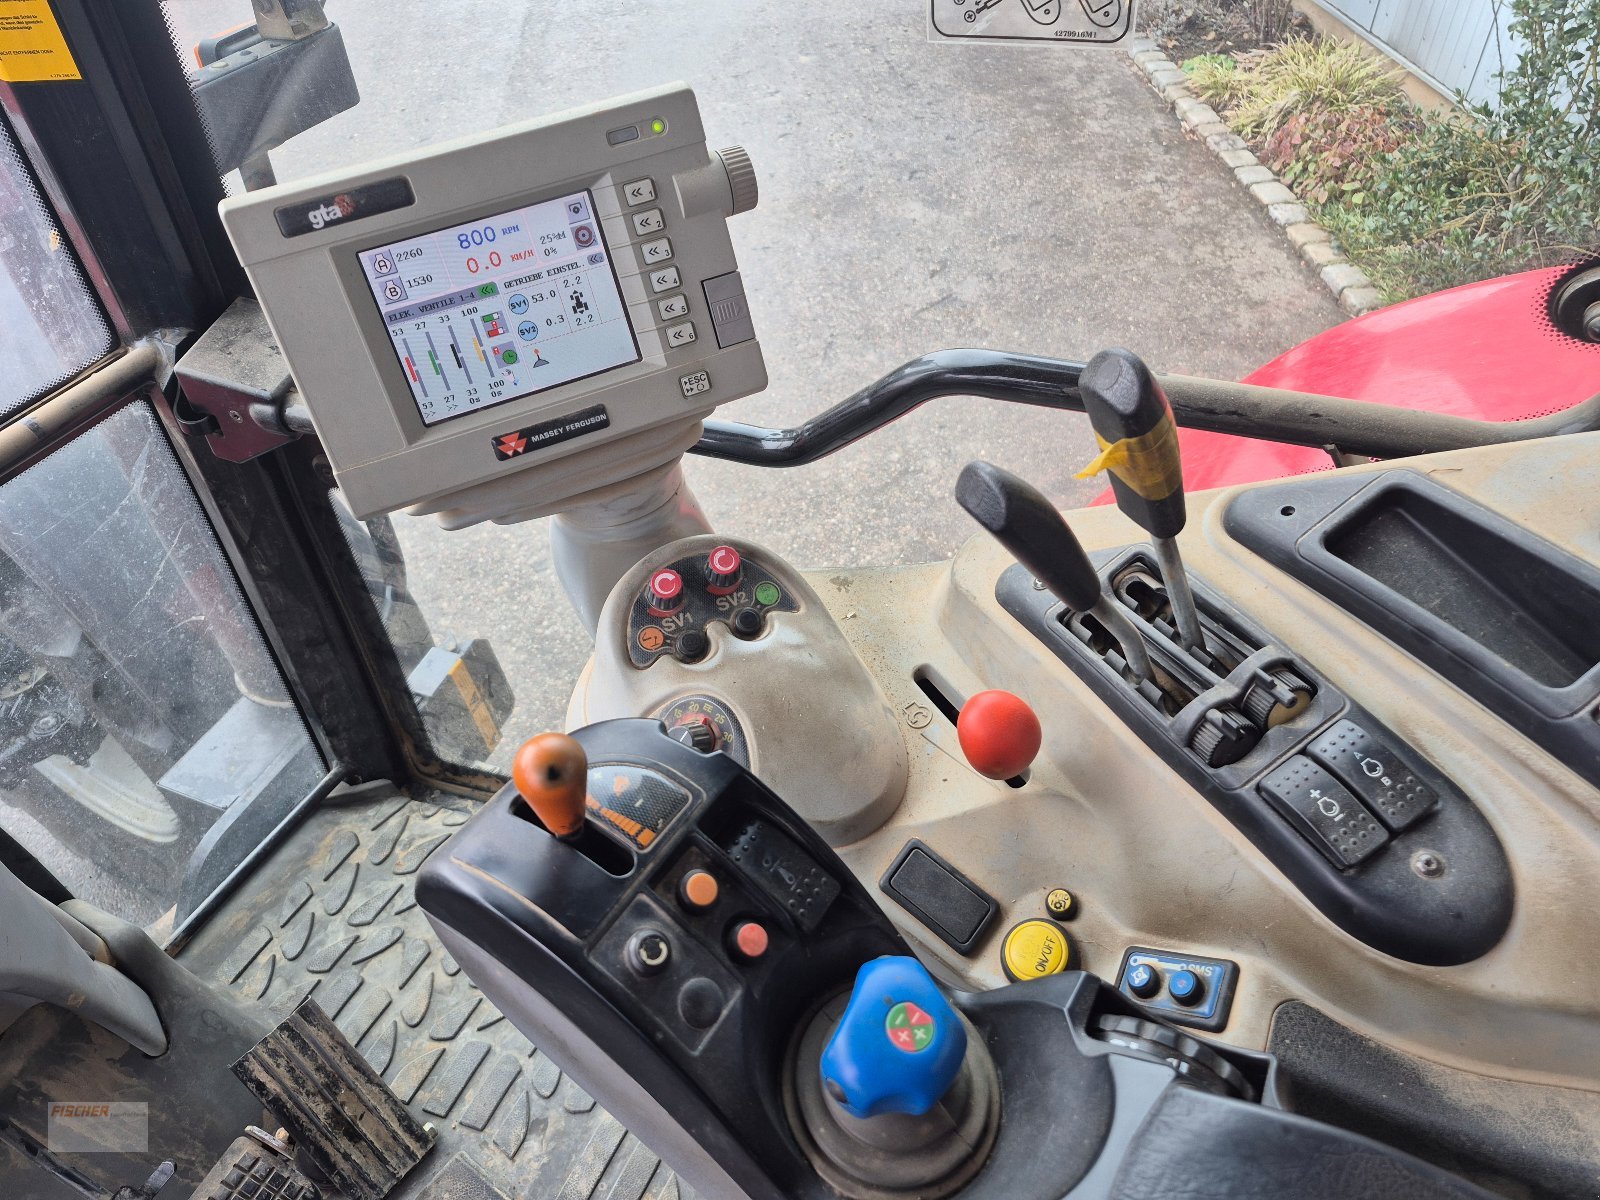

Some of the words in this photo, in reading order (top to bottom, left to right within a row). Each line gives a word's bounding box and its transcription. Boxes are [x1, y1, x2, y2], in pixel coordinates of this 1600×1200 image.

[1054, 30, 1097, 39] 4279916M1
[656, 220, 662, 228] 2
[458, 226, 496, 249] 800
[502, 225, 520, 236] RPM
[395, 247, 423, 262] 2260
[544, 247, 557, 257] 0%
[665, 249, 670, 257] 3
[378, 259, 388, 271] A
[467, 251, 501, 273] 0.0
[510, 249, 535, 263] KM/H
[406, 274, 433, 289] 1530
[504, 272, 543, 289] GETRIEBE
[547, 262, 585, 277] EINSTEL.
[563, 276, 582, 288] 2.2
[673, 277, 678, 285] 4
[388, 286, 398, 297] B
[510, 299, 527, 310] SV1
[531, 290, 556, 304] 53.0
[388, 309, 415, 323] ELEK.
[419, 299, 456, 314] VENTILE
[459, 292, 475, 302] 1-4
[392, 328, 404, 337] 53
[415, 321, 426, 331] 27
[438, 315, 450, 323] 33
[461, 306, 478, 317] 100
[520, 325, 537, 336] SV2
[546, 314, 565, 327] 0.3
[576, 314, 594, 326] 2.2
[688, 373, 706, 386] ESC
[422, 401, 434, 410] 53
[444, 395, 455, 404] 27
[466, 387, 478, 396] 33
[488, 379, 505, 390] 100
[531, 427, 564, 443] MASSEY
[566, 413, 607, 431] FERGUSON
[716, 591, 749, 612] SV2
[662, 611, 694, 633] SV1
[674, 708, 683, 718] 15
[688, 701, 699, 712] 20
[714, 713, 725, 724] 25
[723, 731, 734, 743] 30
[1380, 776, 1392, 787] B
[1035, 935, 1056, 973] ON/OFF
